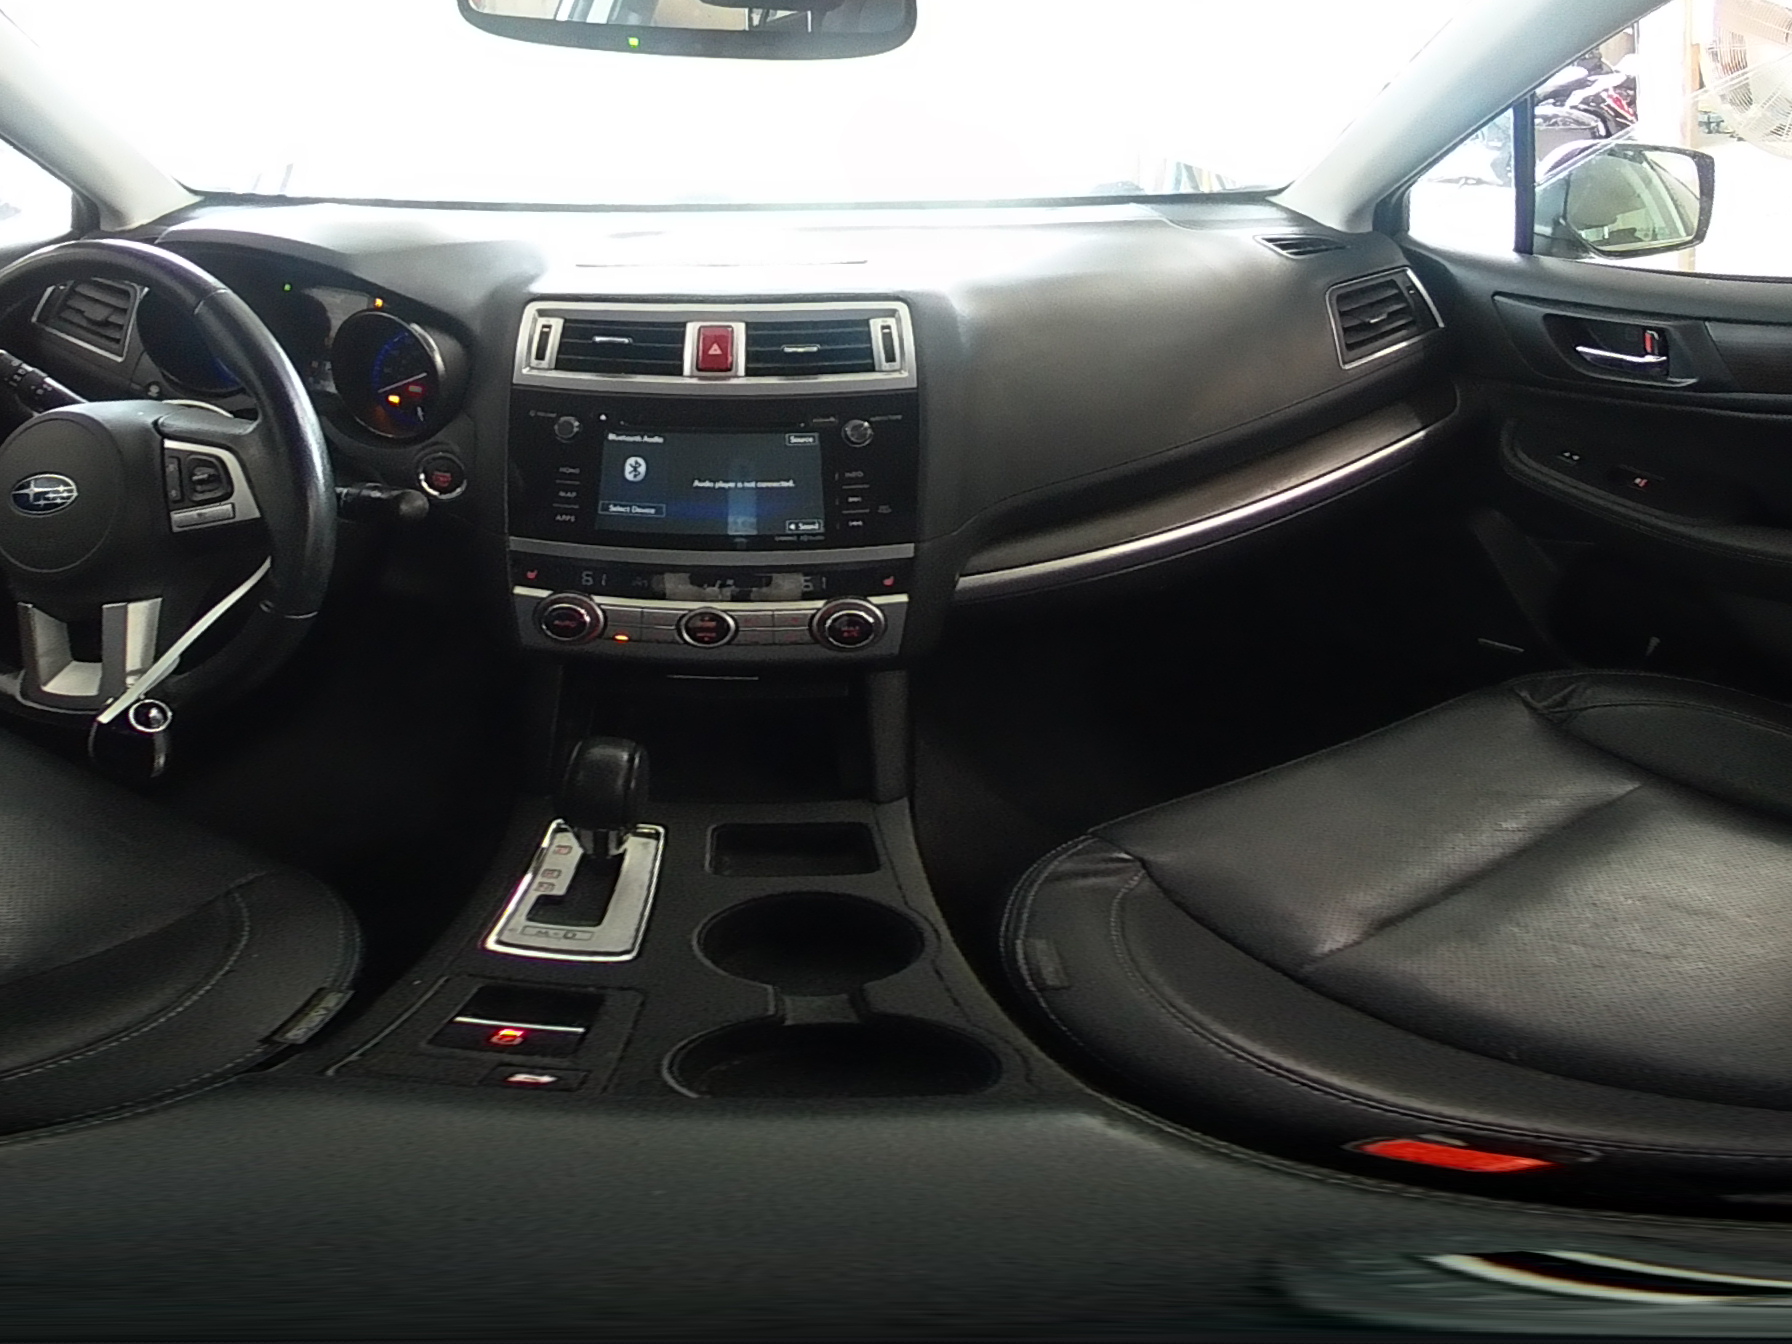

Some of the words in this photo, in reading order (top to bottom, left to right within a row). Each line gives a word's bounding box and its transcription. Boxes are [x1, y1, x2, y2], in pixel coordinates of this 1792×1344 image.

[643, 434, 664, 444] Audio
[790, 435, 814, 444] Source
[692, 479, 714, 488] Audio
[714, 480, 736, 489] player
[756, 479, 796, 488] connected.
[608, 504, 630, 513] Select
[631, 505, 656, 515] Device
[555, 514, 576, 522] APPS
[798, 522, 819, 531] Sound
